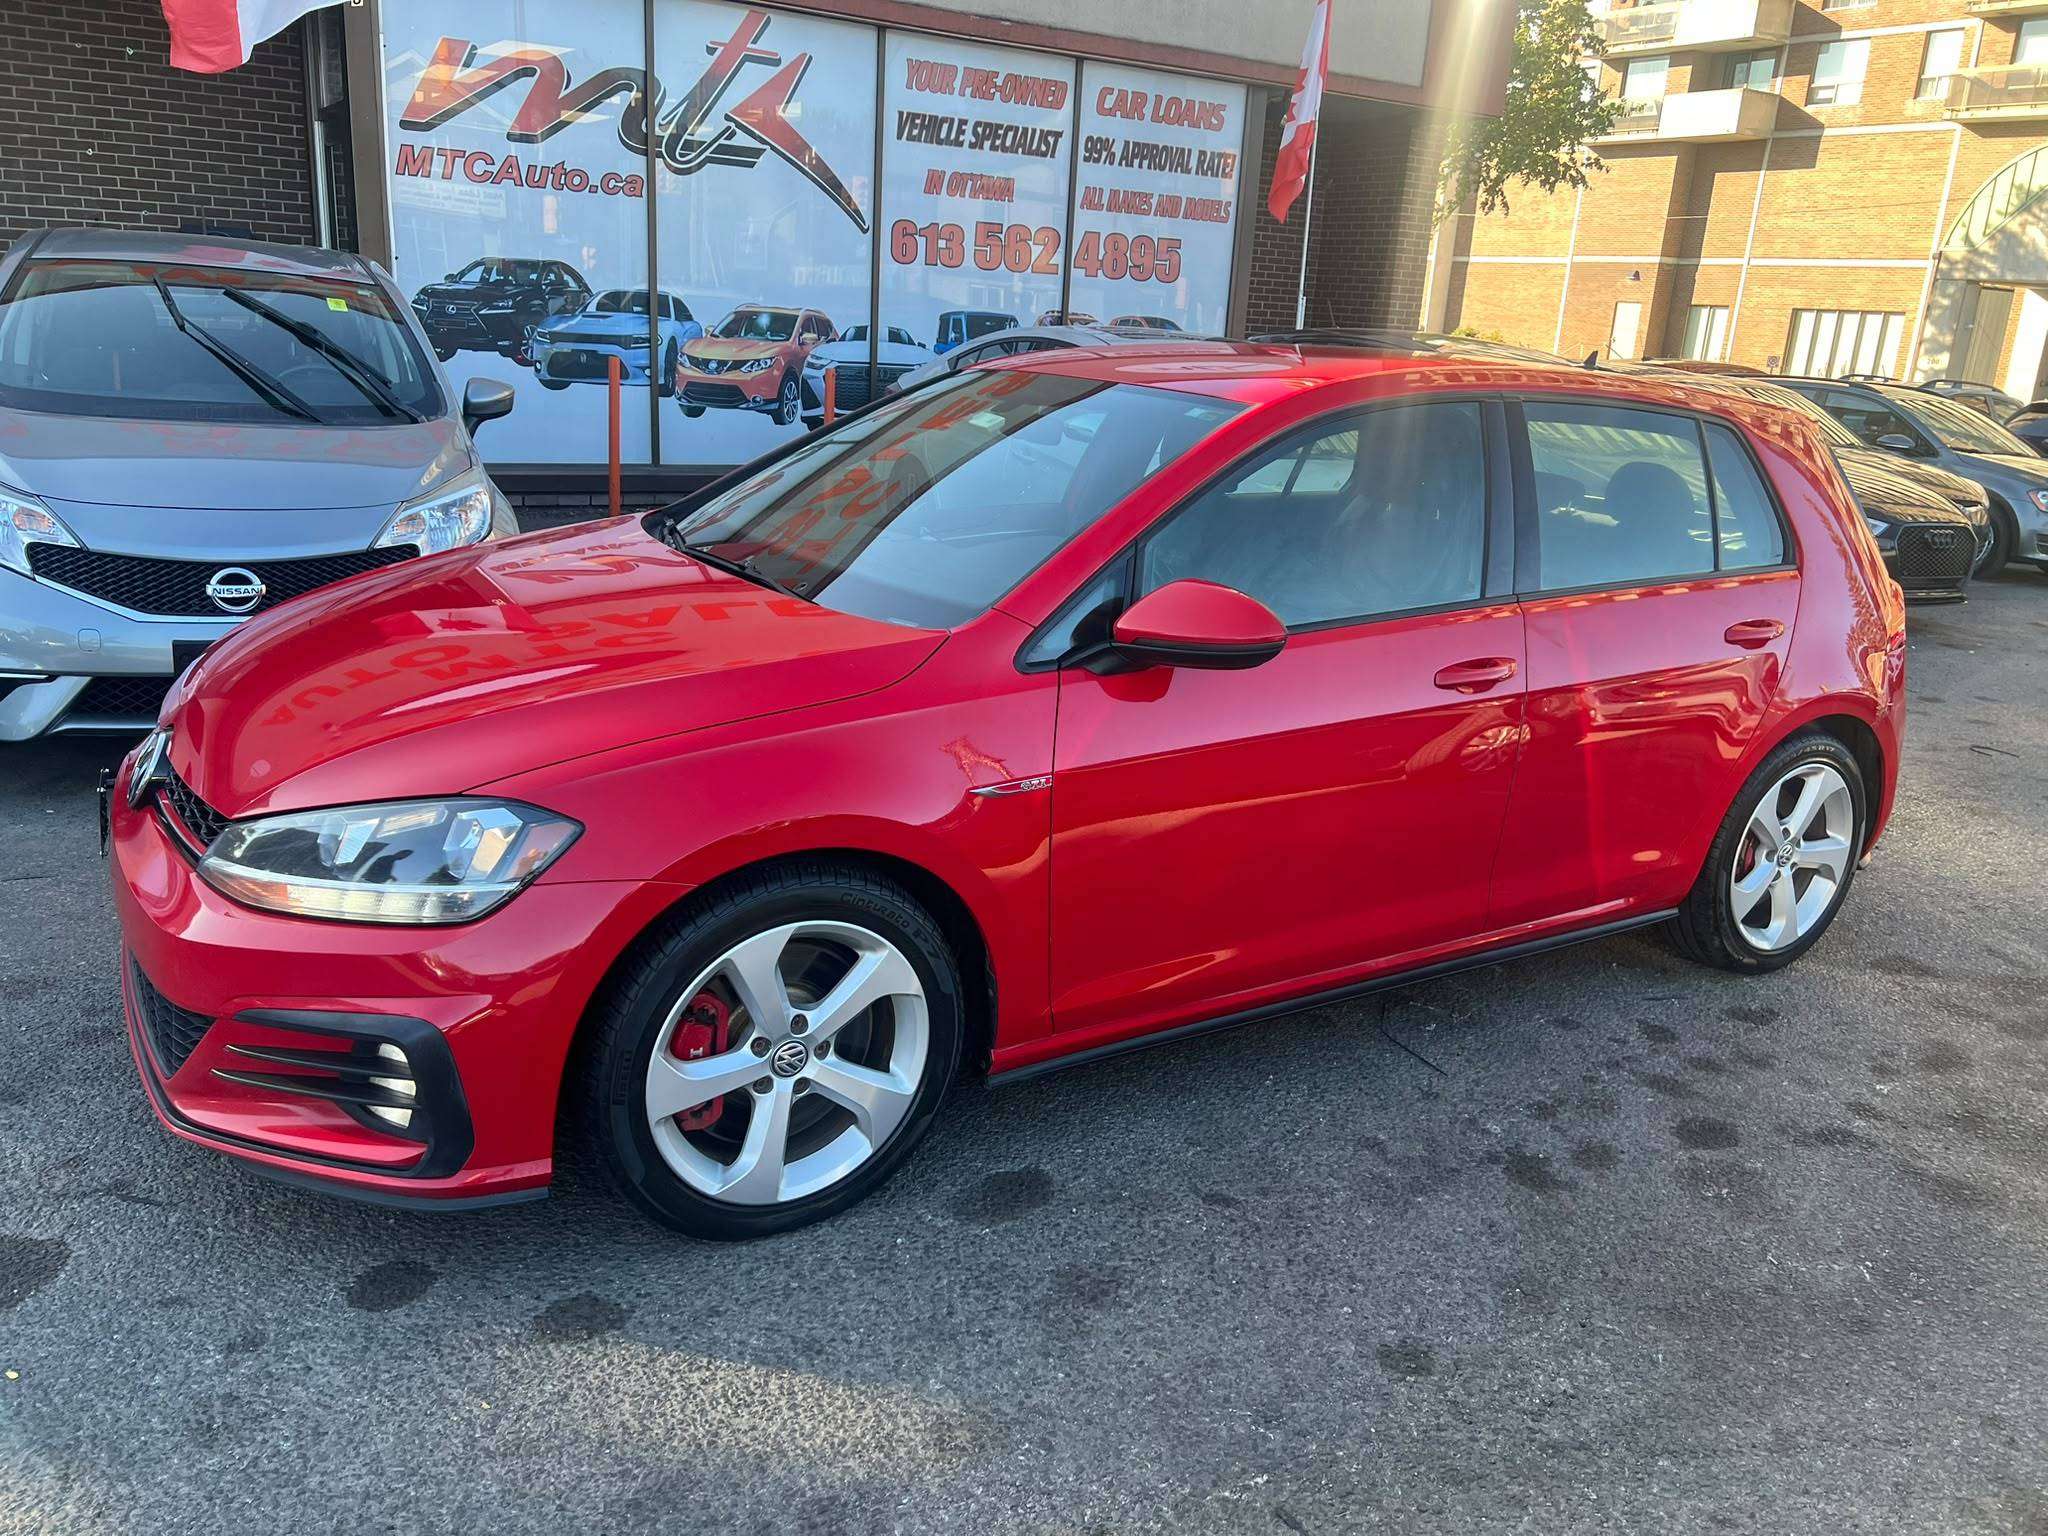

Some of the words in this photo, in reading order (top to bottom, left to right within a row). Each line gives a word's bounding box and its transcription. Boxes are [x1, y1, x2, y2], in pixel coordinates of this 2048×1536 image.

[906, 57, 958, 95] YOUR
[959, 66, 1068, 110] PRE-OWNED
[1096, 86, 1148, 121] CAR
[1150, 94, 1227, 132] LOANS
[896, 110, 969, 149] VEHICLE
[968, 120, 1064, 159] SPECIALIST
[1083, 135, 1115, 166] 99%
[1118, 140, 1192, 174] APPROVAL
[395, 143, 644, 198] MTCAuto.ca
[923, 169, 946, 195] IN
[946, 171, 1015, 203] OTTAWA
[1080, 186, 1104, 212] ALL
[1106, 189, 1154, 216] MAKES
[1154, 194, 1182, 219] AND
[1182, 197, 1232, 224] MODELS
[891, 219, 965, 268] 613
[973, 221, 1061, 275] 562
[1073, 231, 1182, 283] 4895
[212, 587, 260, 596] NISSAN
